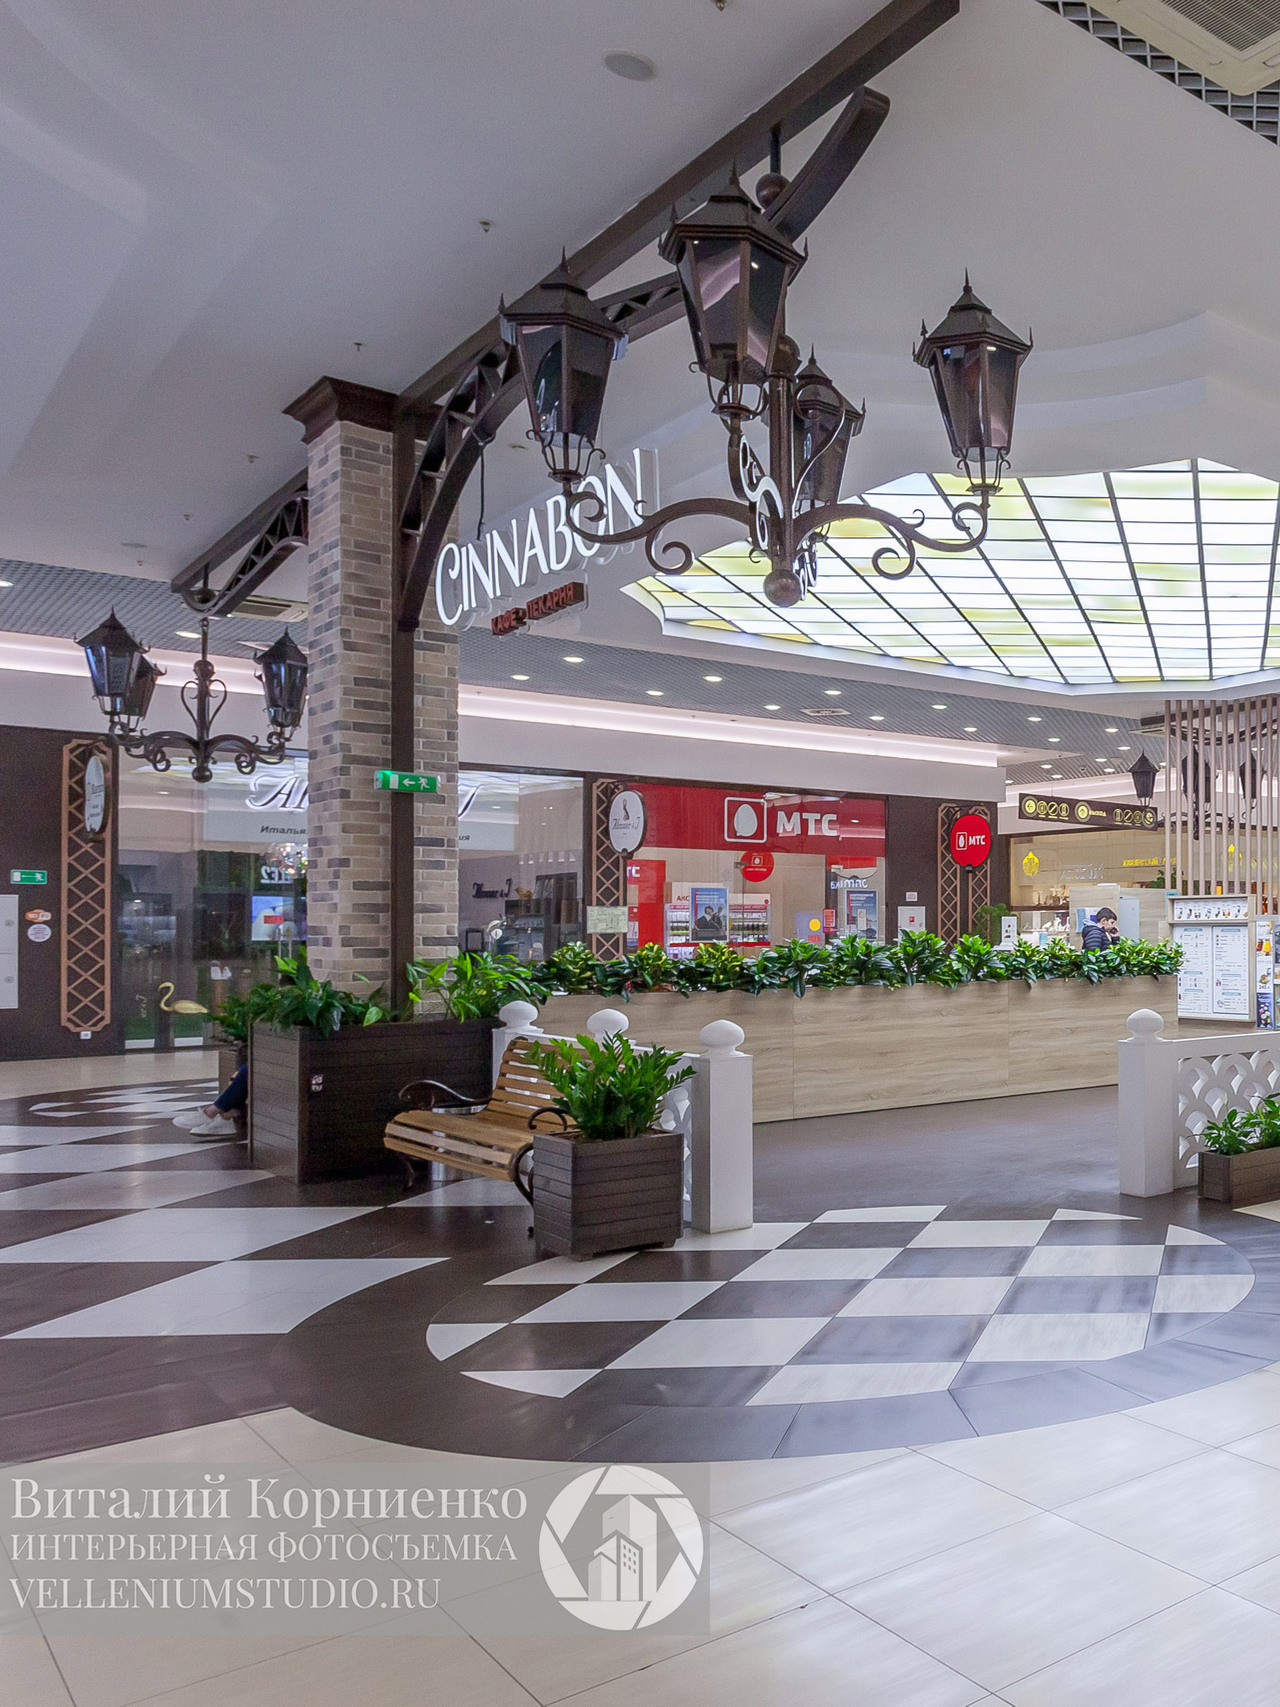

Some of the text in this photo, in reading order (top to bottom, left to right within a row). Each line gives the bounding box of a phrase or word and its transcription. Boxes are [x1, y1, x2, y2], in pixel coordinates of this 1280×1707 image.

[435, 448, 643, 625] CINNABON
[776, 810, 838, 837] МТС
[968, 835, 986, 846] МТС
